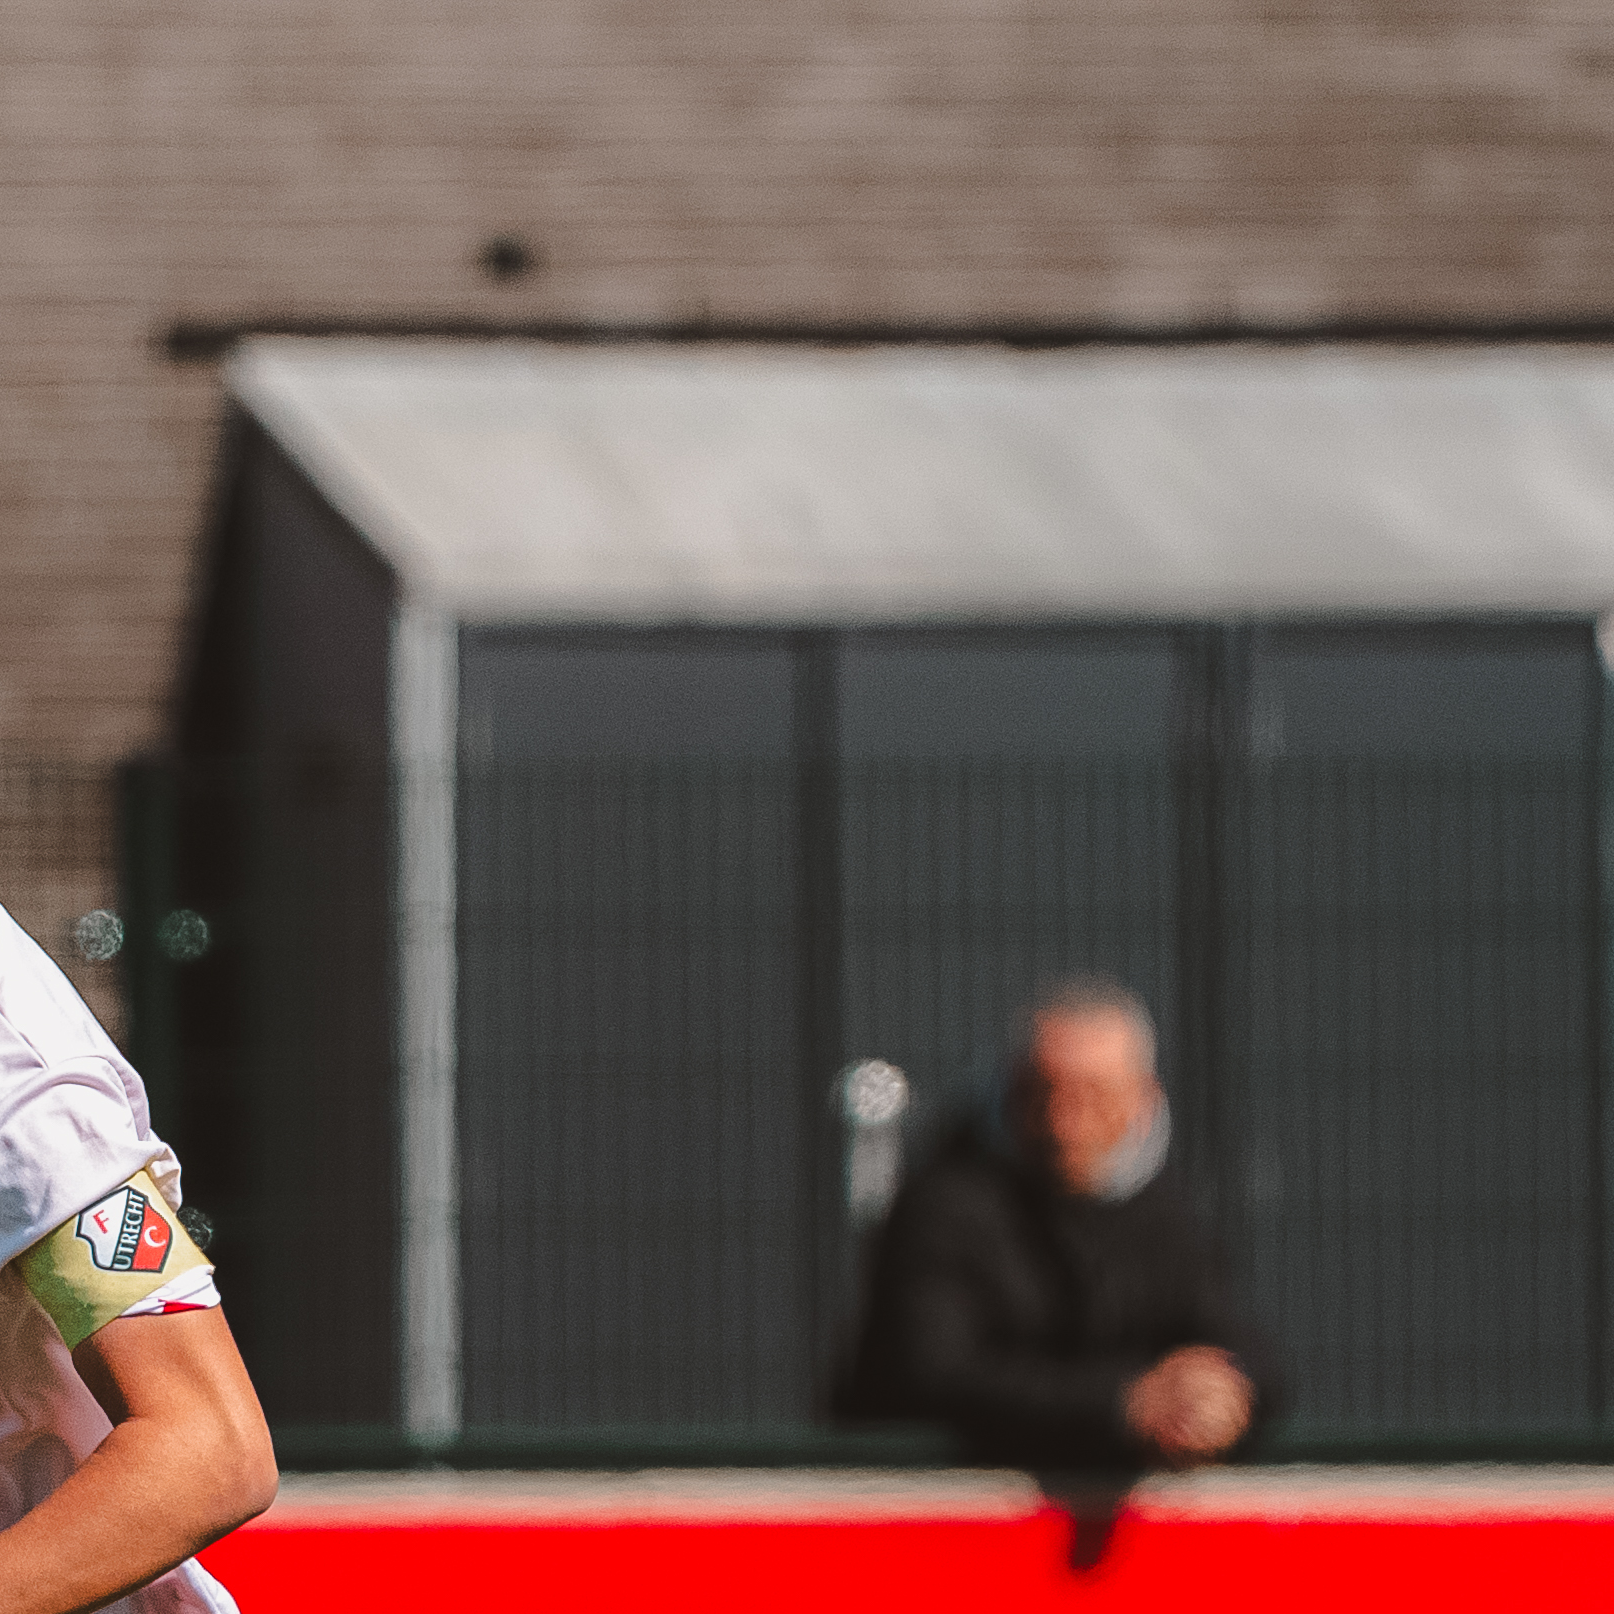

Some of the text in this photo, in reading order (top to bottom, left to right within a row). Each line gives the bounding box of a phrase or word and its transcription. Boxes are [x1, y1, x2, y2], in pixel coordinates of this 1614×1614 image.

[92, 1209, 109, 1235] F
[113, 1190, 146, 1271] UTRECHT
[143, 1225, 167, 1249] C
